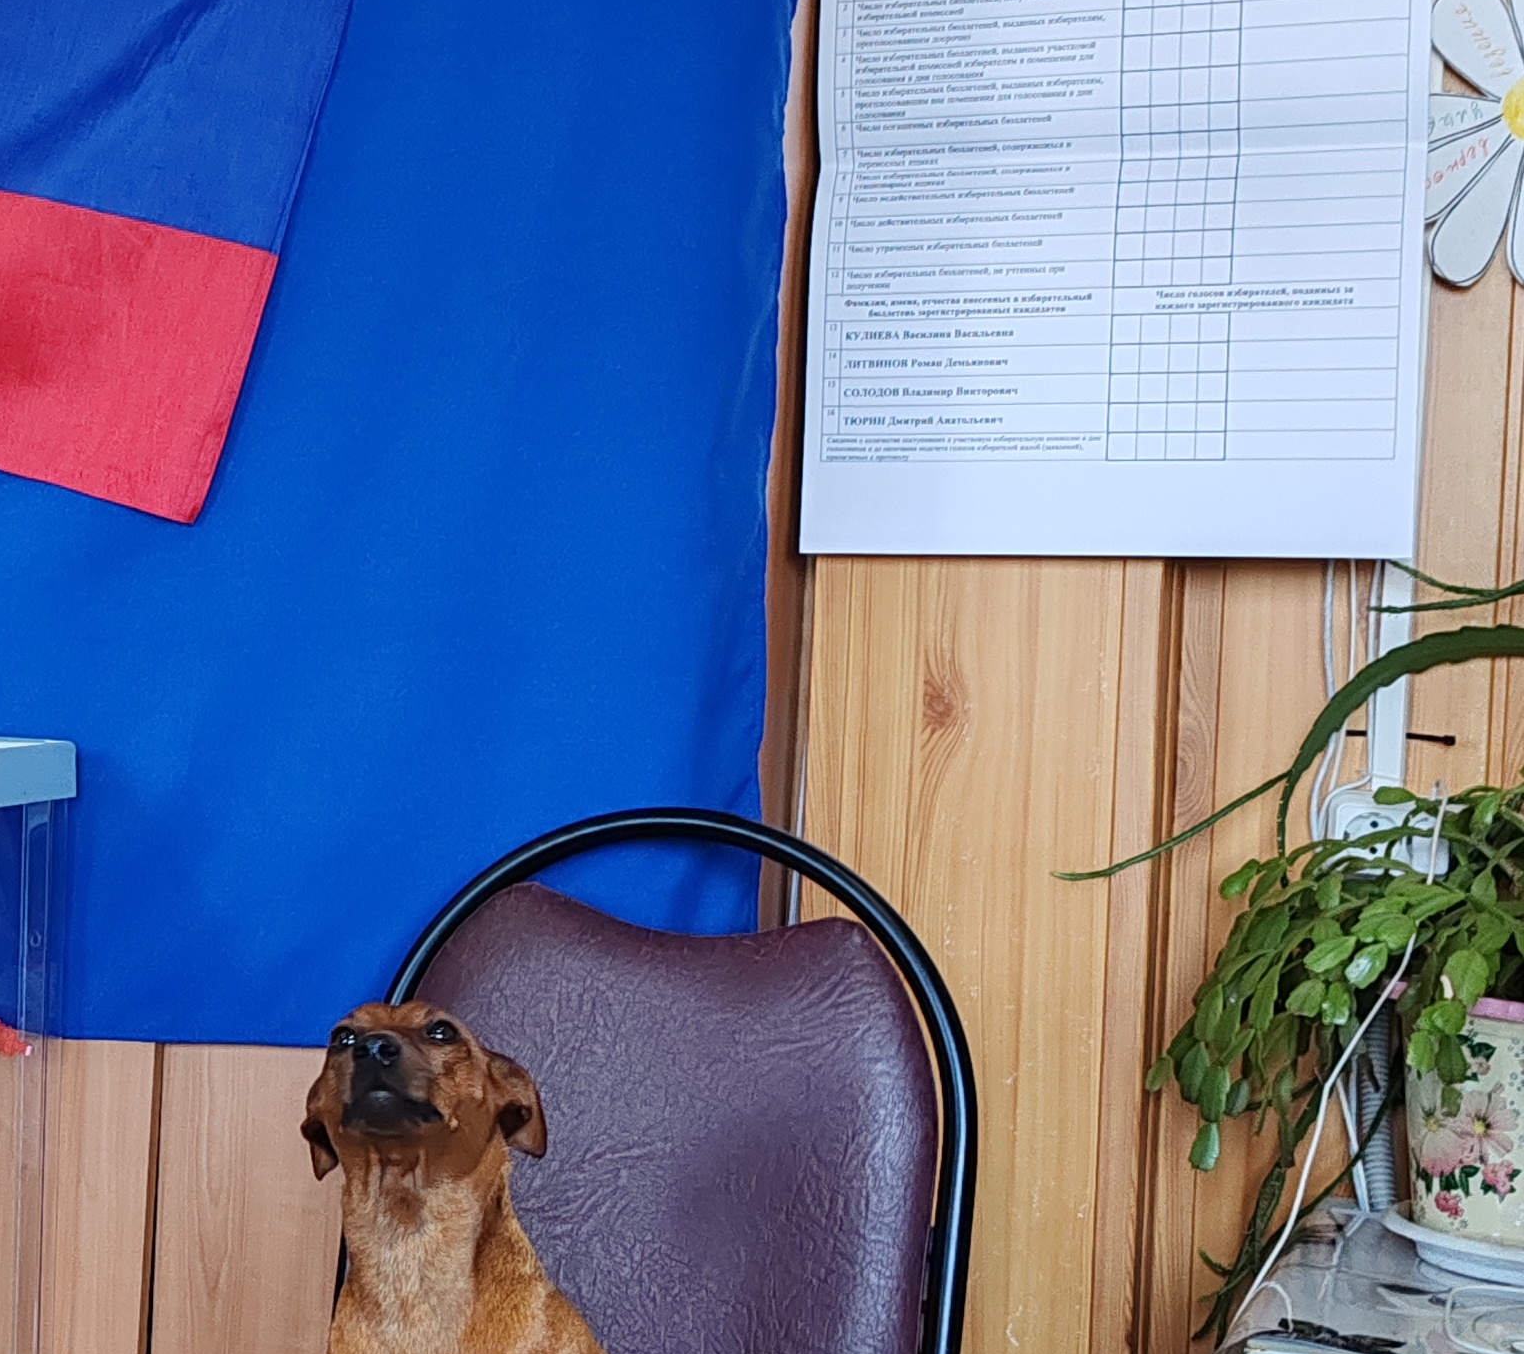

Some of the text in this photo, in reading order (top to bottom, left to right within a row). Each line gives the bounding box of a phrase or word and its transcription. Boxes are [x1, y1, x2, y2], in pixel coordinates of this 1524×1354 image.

[845, 329, 1014, 342] КУЛИЕВА Василина Васильевна
[844, 358, 1008, 369] ЛИТВИНОВ Роман Демьянович
[843, 387, 1018, 398] СОЛОДОВ Владимир Викторович
[843, 416, 1003, 427] ТЮРИН Дмитрий Анатольевич
